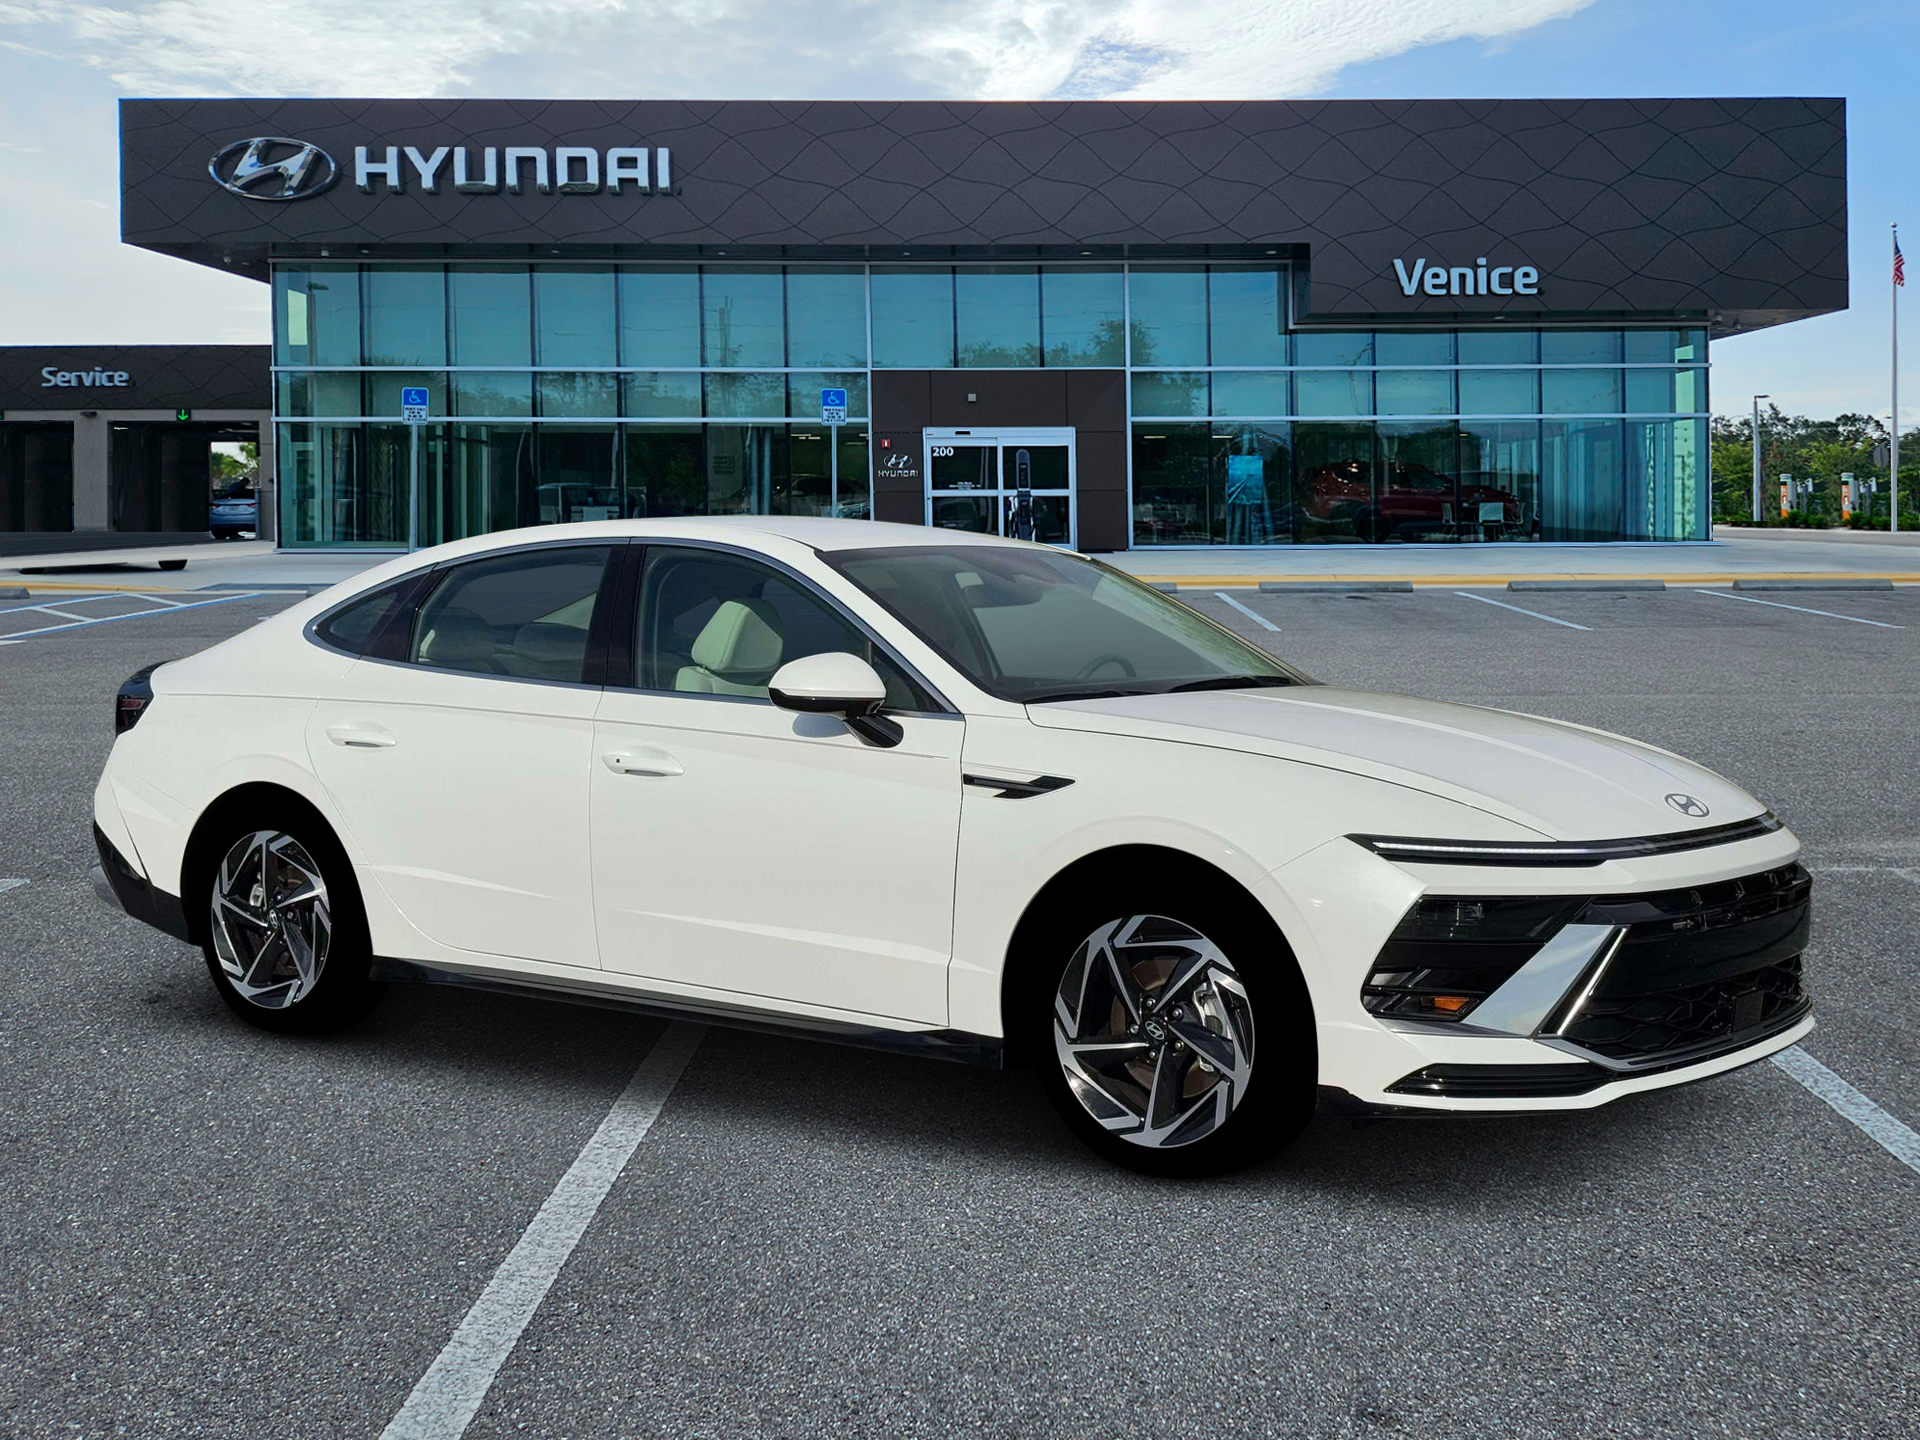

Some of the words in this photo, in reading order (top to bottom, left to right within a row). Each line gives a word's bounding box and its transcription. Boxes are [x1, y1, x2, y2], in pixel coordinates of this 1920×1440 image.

[354, 146, 672, 193] HYUNDAI
[1393, 257, 1539, 296] Venice
[41, 366, 130, 387] Service
[932, 446, 954, 457] 200
[878, 469, 919, 478] HYUNDAI
